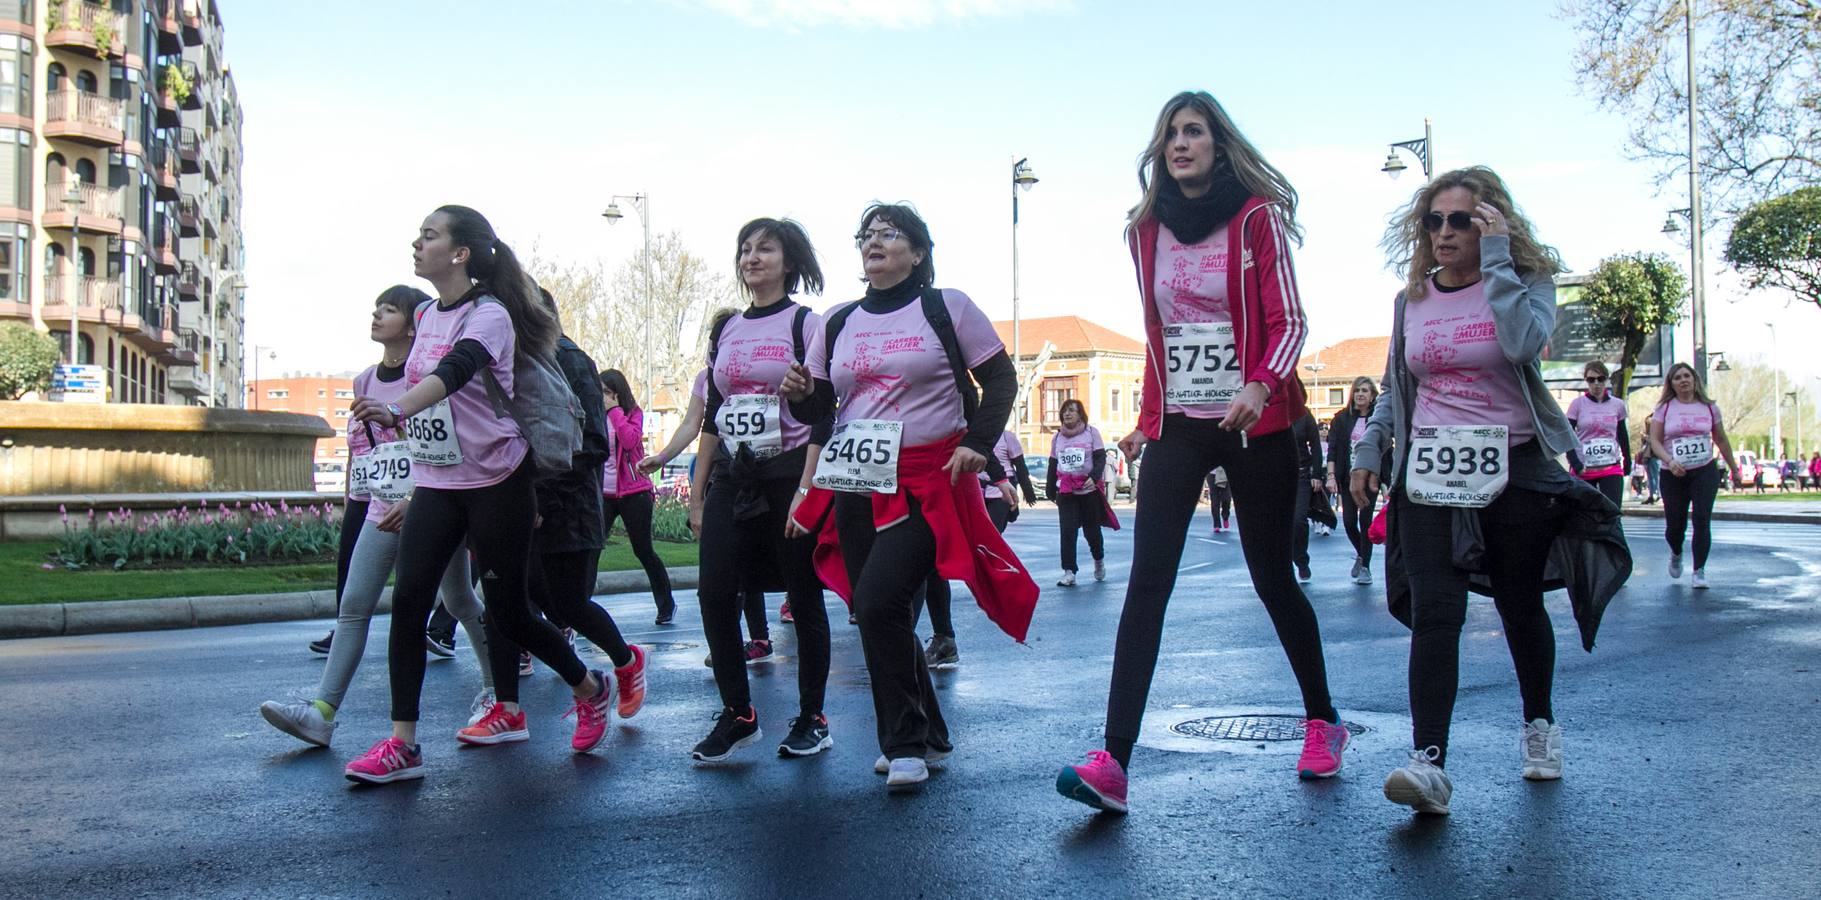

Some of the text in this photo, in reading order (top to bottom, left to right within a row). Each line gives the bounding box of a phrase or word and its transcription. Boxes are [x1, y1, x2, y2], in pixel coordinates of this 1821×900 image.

[1458, 328, 1495, 338] MUJER
[889, 336, 924, 344] CARRERA
[886, 342, 919, 350] MUJER
[1168, 344, 1242, 372] 5752
[1175, 389, 1233, 398] NATUR HOUSE
[408, 417, 448, 441] 3668
[725, 412, 765, 436] 559
[825, 438, 891, 465] 5465
[1586, 445, 1612, 456] 4657
[1676, 443, 1706, 456] 6121
[1061, 455, 1082, 464] 3906
[1415, 447, 1500, 475] 5938
[369, 457, 410, 480] 2749
[828, 477, 882, 487] NATUR HOUSE
[1425, 492, 1489, 501] NATUR HOUSE
